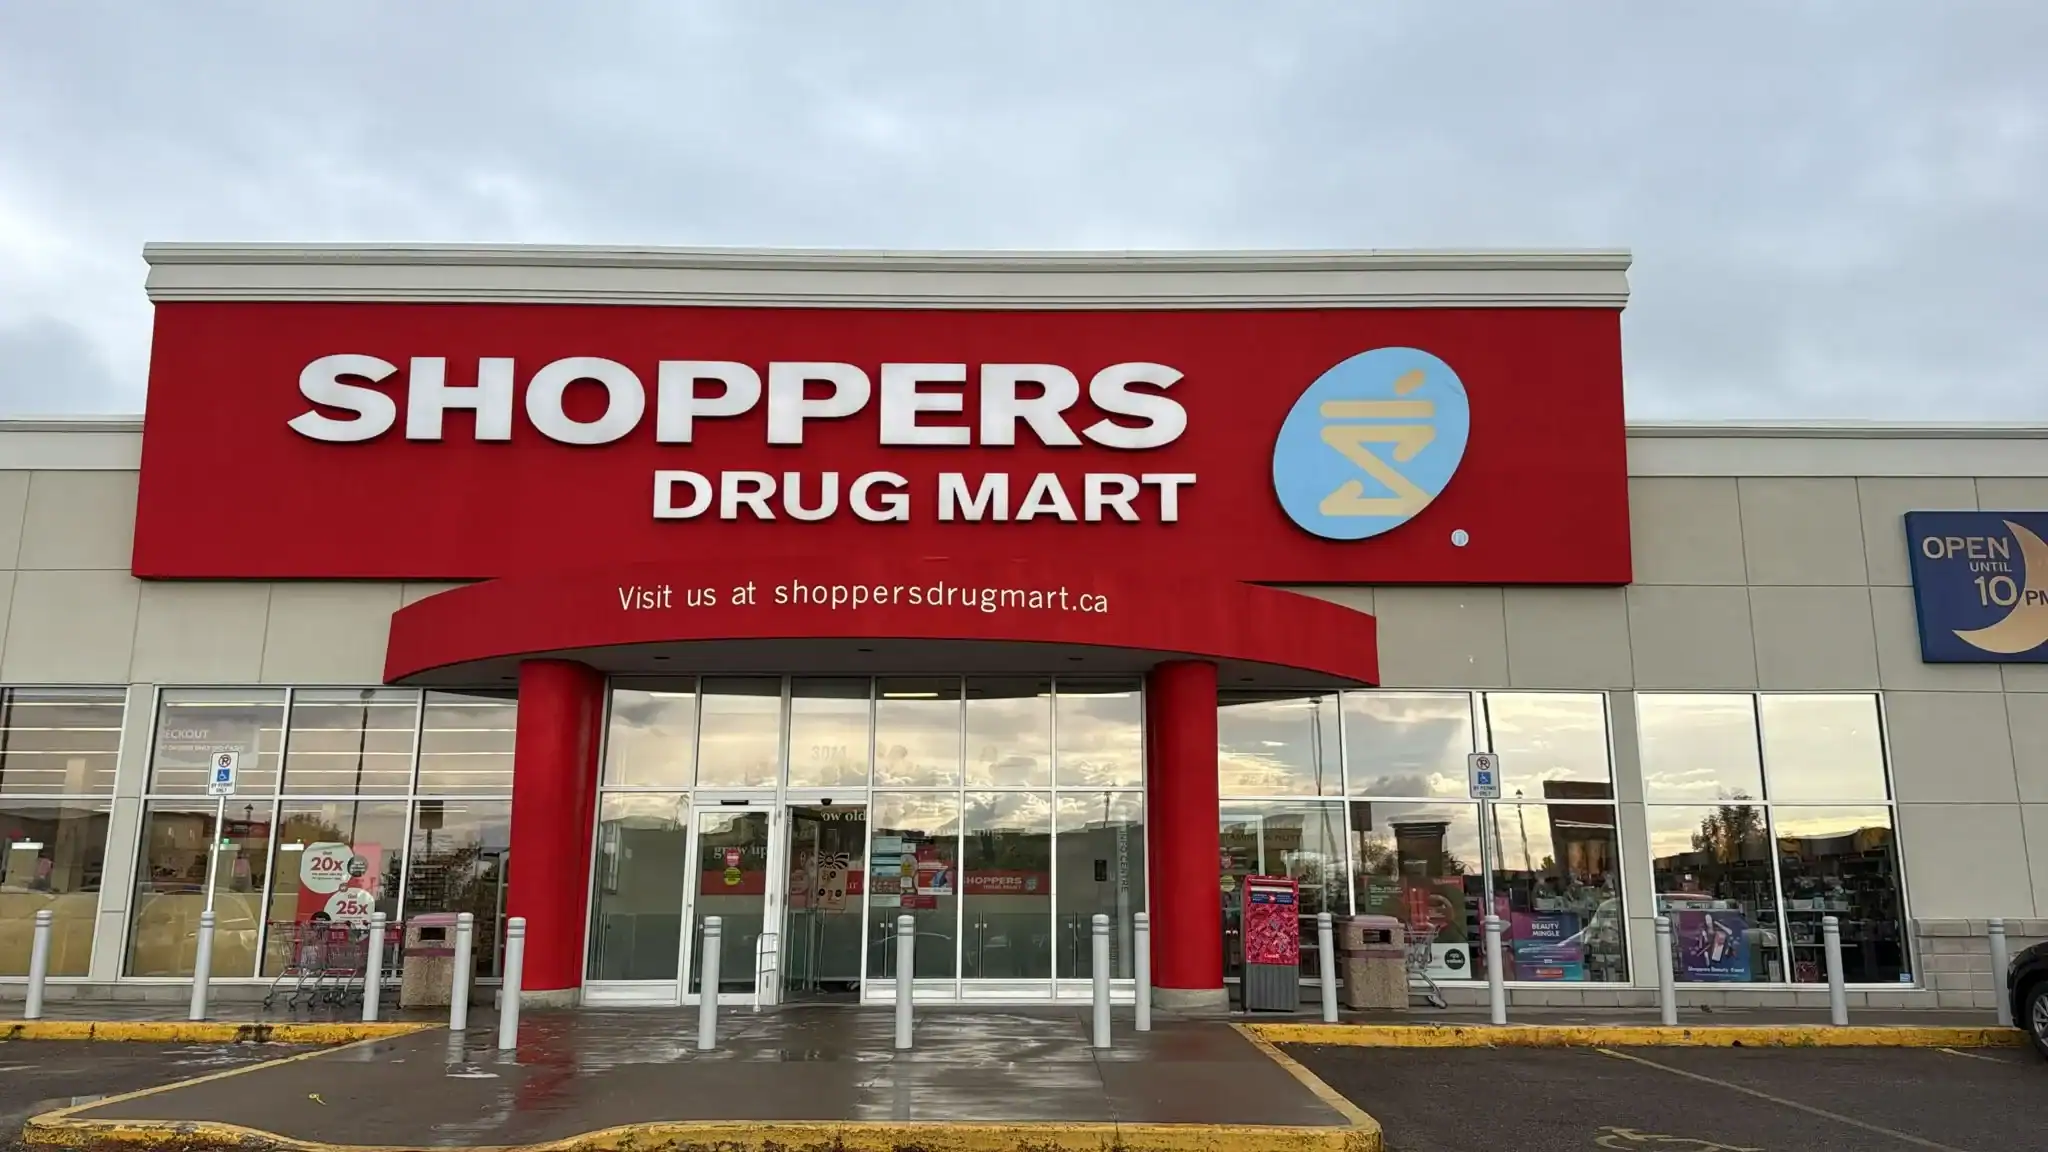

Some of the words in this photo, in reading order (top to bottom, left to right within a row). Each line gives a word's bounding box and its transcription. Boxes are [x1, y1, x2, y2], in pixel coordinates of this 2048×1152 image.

[287, 353, 1188, 449] SHOPPERS
[653, 469, 910, 522] DRUG
[938, 472, 1197, 522] MART
[1922, 536, 2011, 559] OPEN
[1969, 561, 2013, 572] UNTIL
[618, 584, 673, 611] Visit
[687, 587, 717, 607] us
[731, 581, 757, 606] at
[774, 579, 1108, 613] shoppersdrugmart.ca
[1974, 575, 2018, 607] 10
[845, 810, 866, 821] old
[714, 846, 748, 859] grw
[310, 856, 344, 872] 20x
[336, 900, 369, 915] 25x
